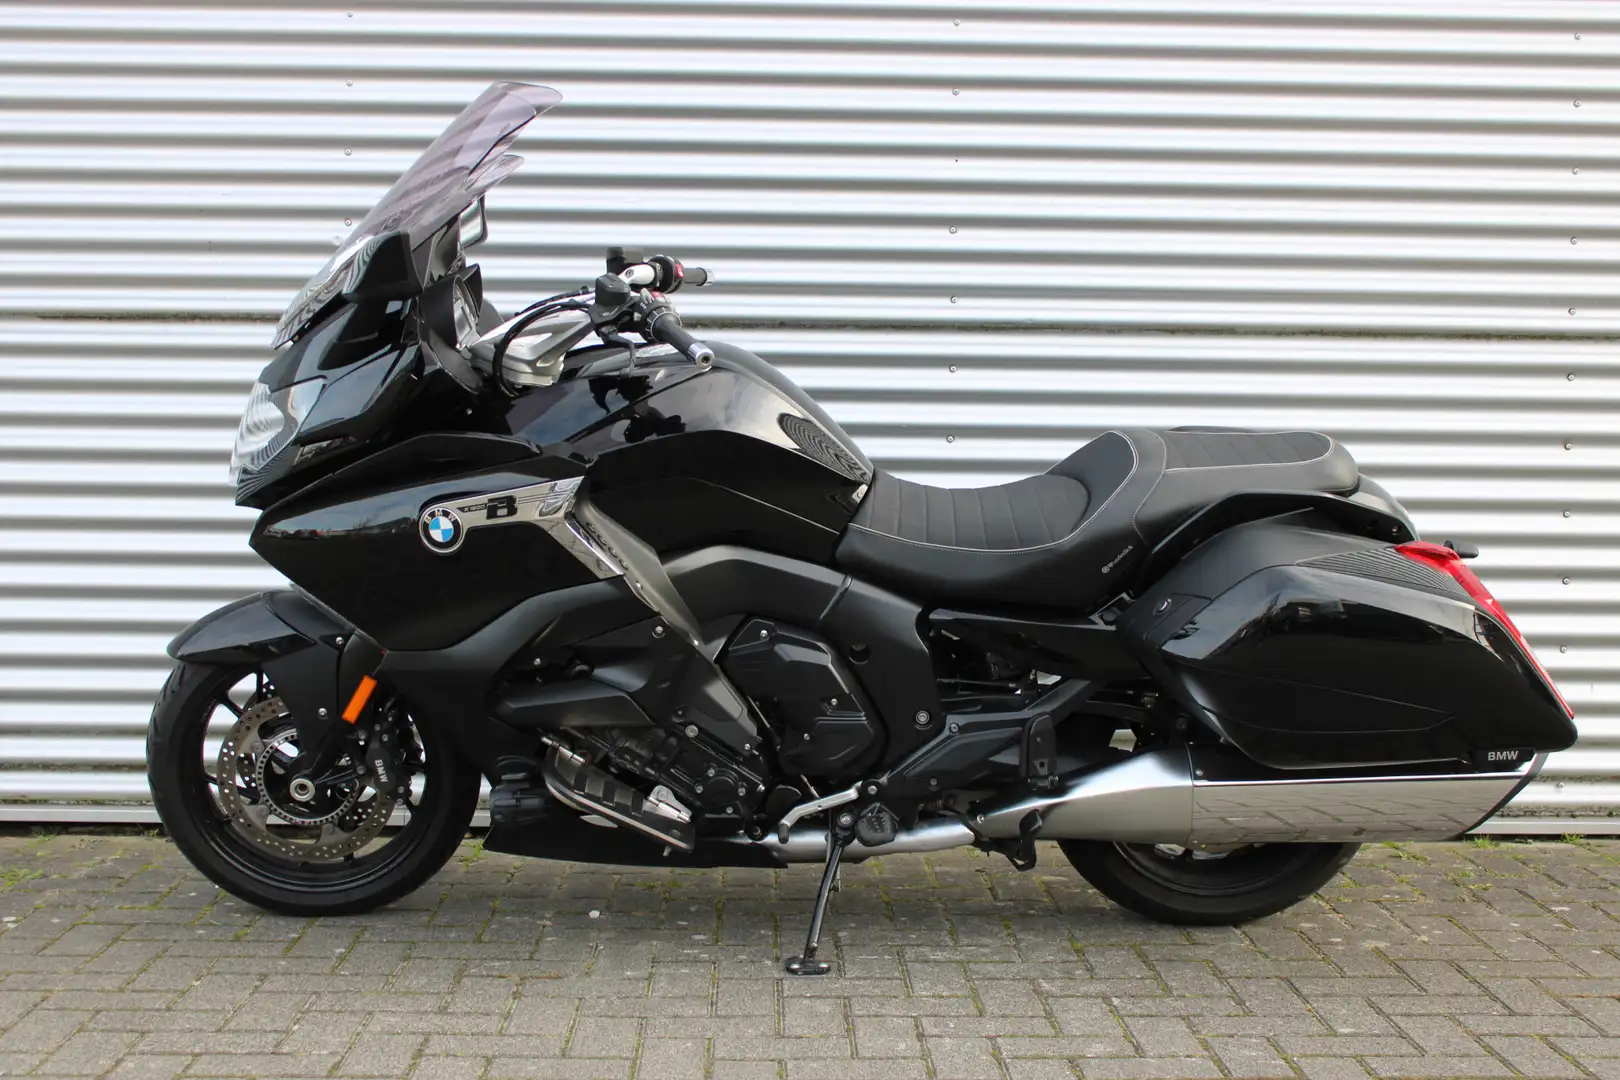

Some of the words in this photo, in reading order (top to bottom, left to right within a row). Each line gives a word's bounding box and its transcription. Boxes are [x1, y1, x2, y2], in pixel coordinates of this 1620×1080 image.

[424, 509, 457, 524] BMW
[1487, 750, 1519, 761] BMW
[375, 760, 388, 782] BMW
